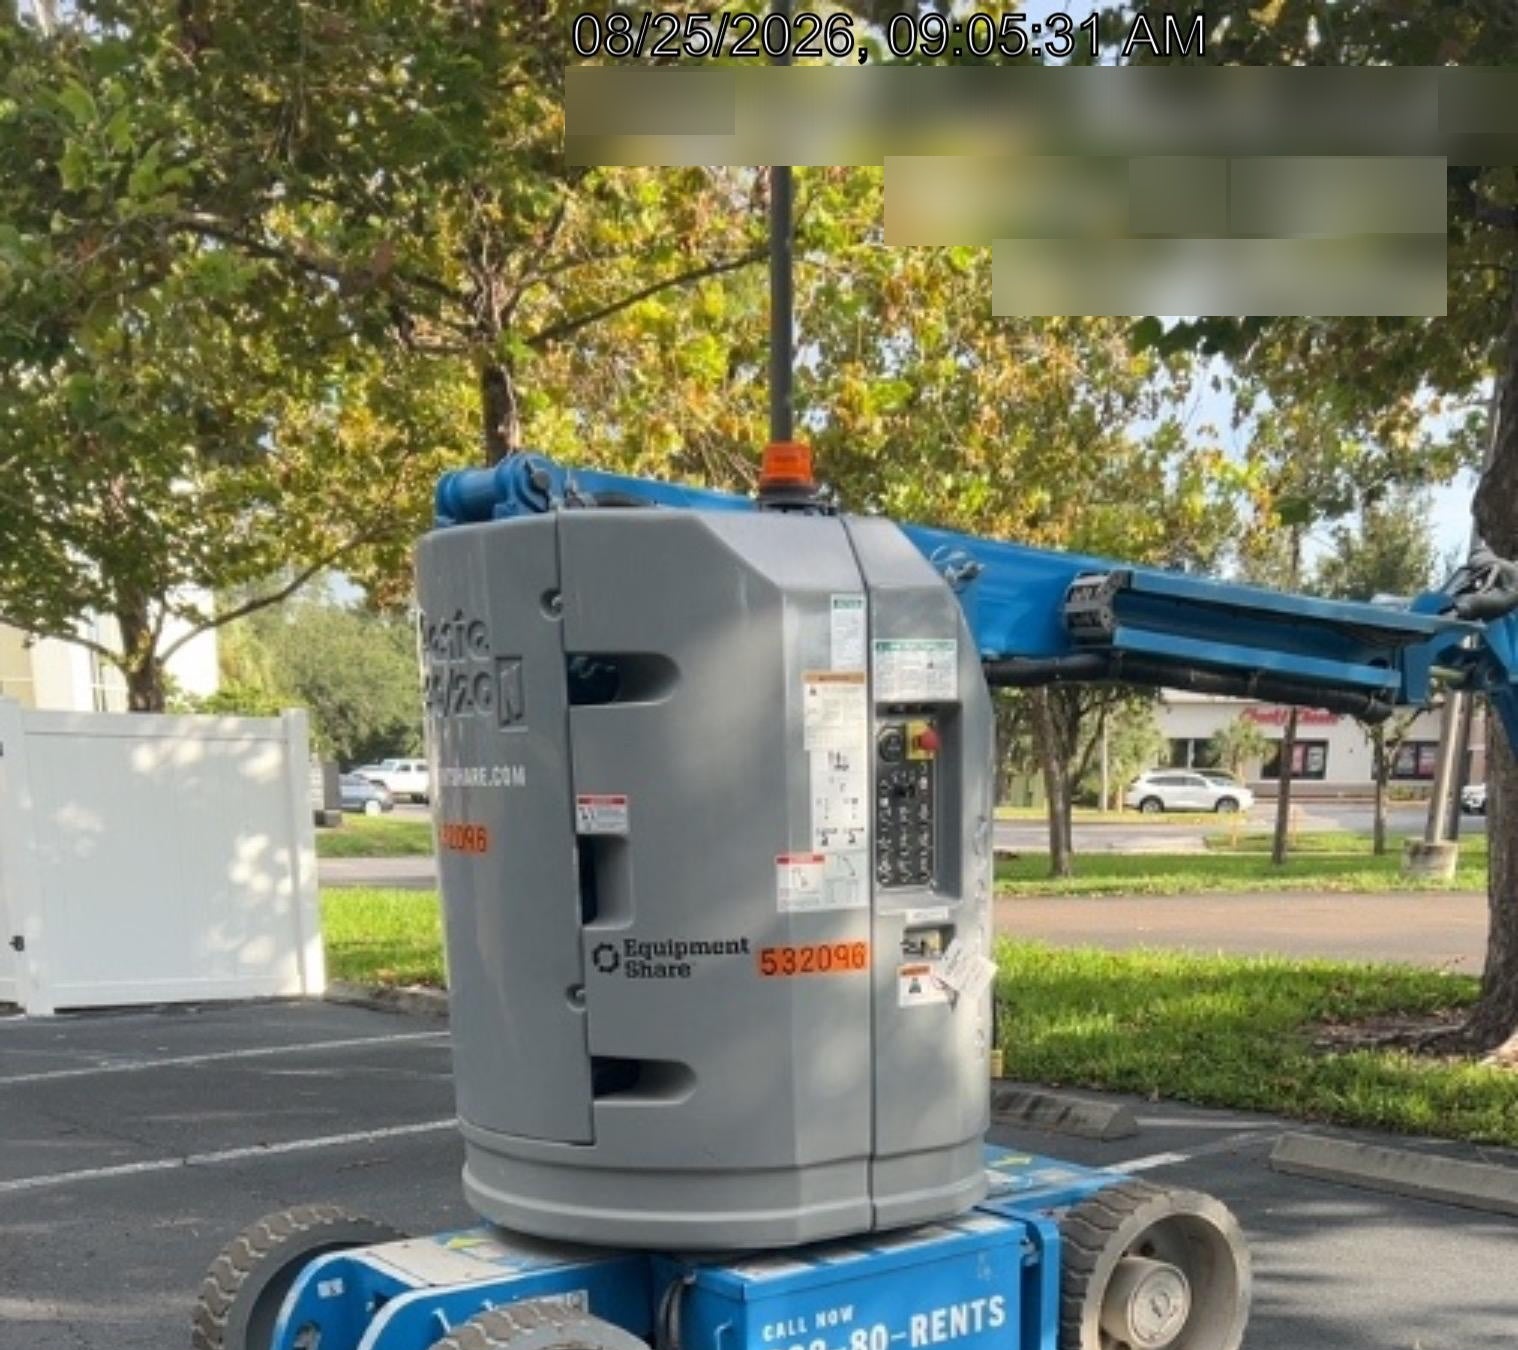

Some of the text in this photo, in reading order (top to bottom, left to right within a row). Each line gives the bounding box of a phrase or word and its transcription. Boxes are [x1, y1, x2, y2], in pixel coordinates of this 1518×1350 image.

[623, 936, 749, 960] Equipment
[760, 942, 867, 976] 532096
[624, 960, 692, 978] Share
[762, 1304, 855, 1343] CALL NOW
